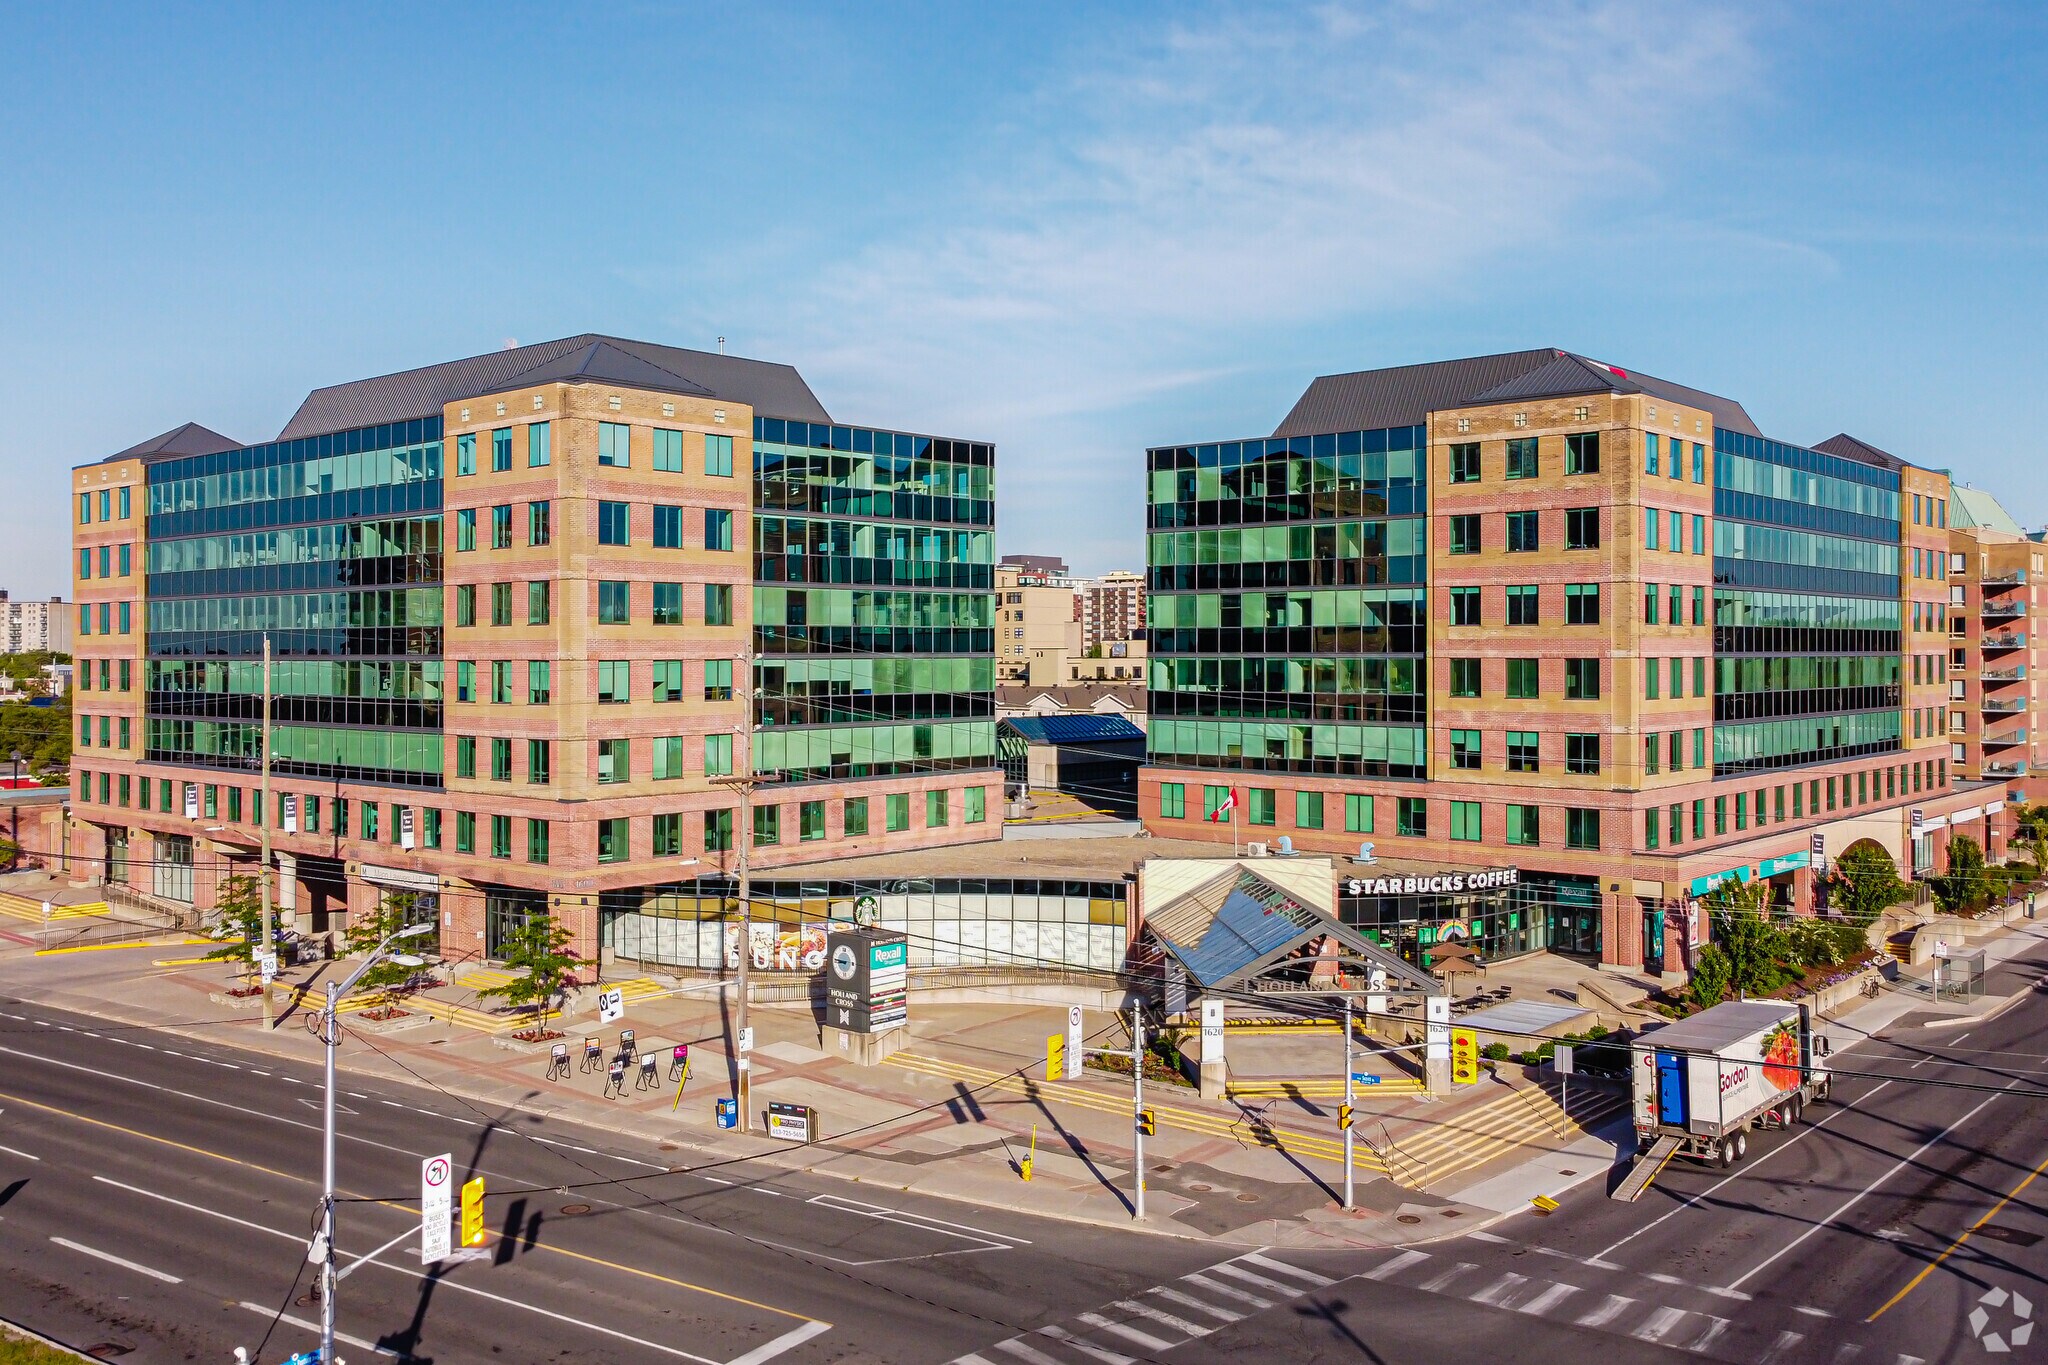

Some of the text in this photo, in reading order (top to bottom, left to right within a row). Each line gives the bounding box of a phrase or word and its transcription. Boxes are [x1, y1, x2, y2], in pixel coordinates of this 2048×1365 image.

[1348, 869, 1518, 895] STARBUCKS COFFEE
[875, 945, 902, 963] Rexall
[263, 961, 275, 971] 50
[830, 989, 858, 1001] HOLLAND
[834, 998, 854, 1008] CROSS
[1202, 1027, 1223, 1037] 1620
[1429, 1024, 1449, 1033] 1620
[1719, 1065, 1749, 1093] Gordon
